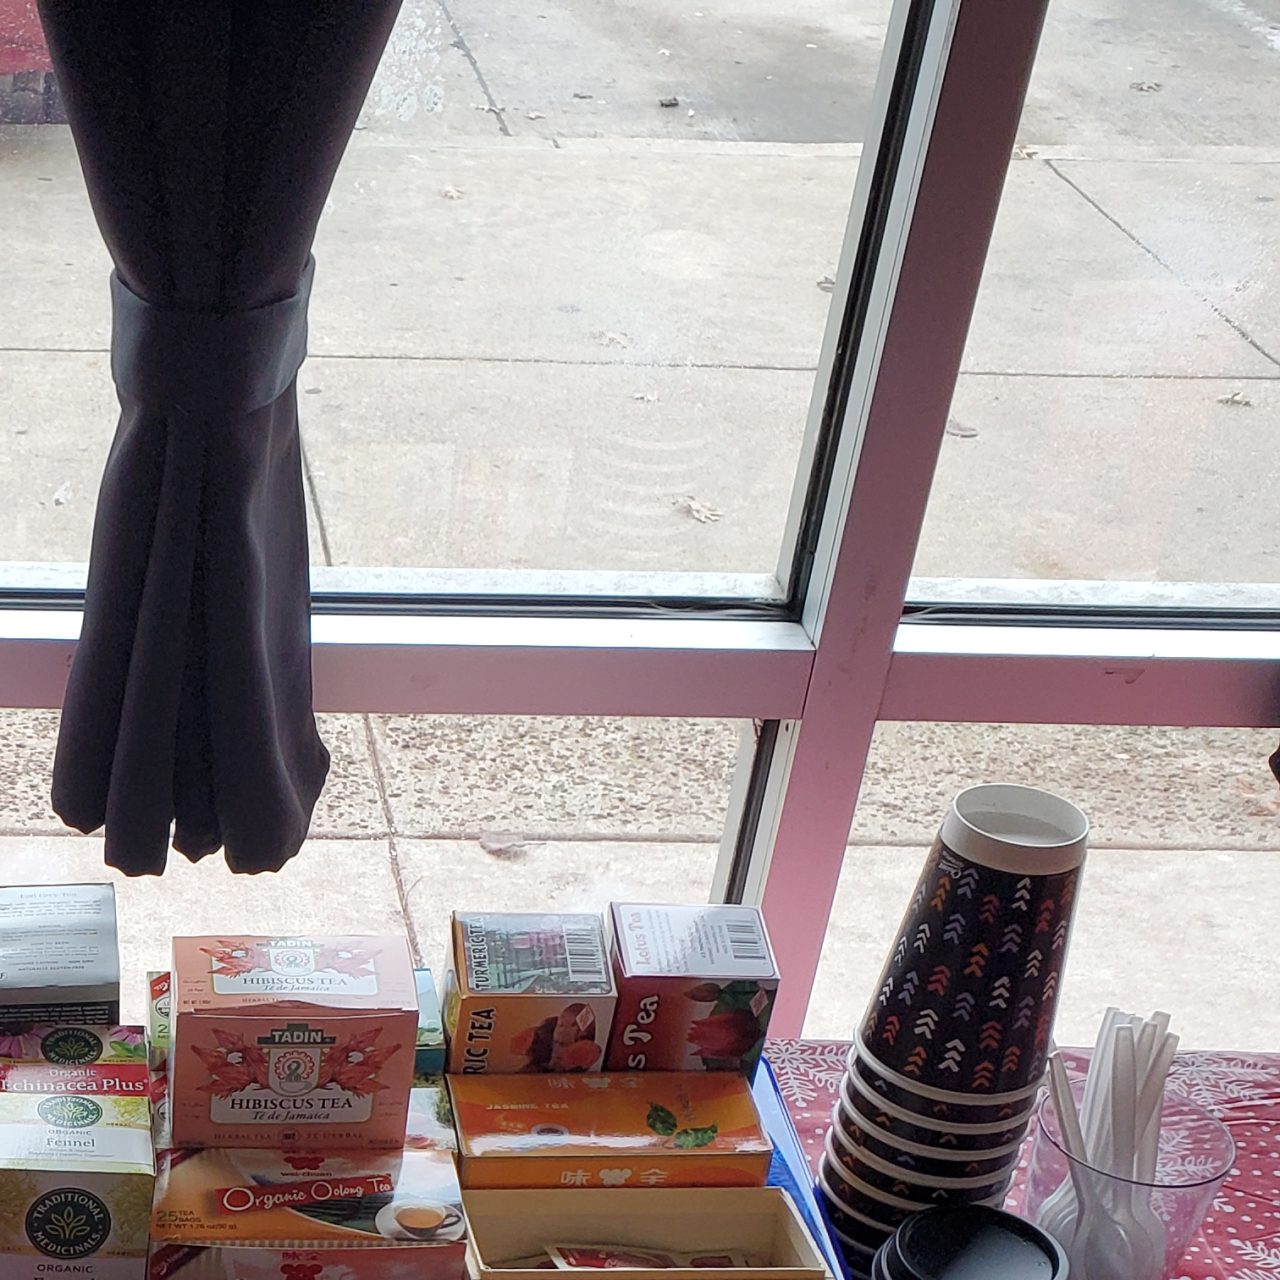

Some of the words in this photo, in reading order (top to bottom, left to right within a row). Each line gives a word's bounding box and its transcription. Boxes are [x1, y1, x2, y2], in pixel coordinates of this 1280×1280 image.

[269, 940, 313, 948] TADIN
[243, 977, 314, 985] HIBISCUS
[318, 977, 347, 985] TEA
[289, 984, 330, 992] Jamaica
[470, 1008, 495, 1045] TEA
[46, 1029, 98, 1046] TRADITIONAL
[271, 1031, 323, 1043] TADIN
[49, 1048, 98, 1065] MEDICINALS
[49, 1067, 97, 1078] Organic
[1, 1078, 98, 1092] Echinacea
[230, 1098, 314, 1110] HIBISCUS
[320, 1098, 353, 1109] TEA
[267, 1111, 281, 1120] de
[282, 1110, 330, 1121] Jamaica
[47, 1137, 96, 1148] Fennel
[223, 1187, 306, 1212] Organic
[311, 1181, 364, 1201] Oolong
[33, 1192, 105, 1222] TRADITIONAL
[157, 1210, 179, 1223] 25
[33, 1230, 102, 1256] MEDICINALS
[36, 1263, 94, 1274] ORGANIC
